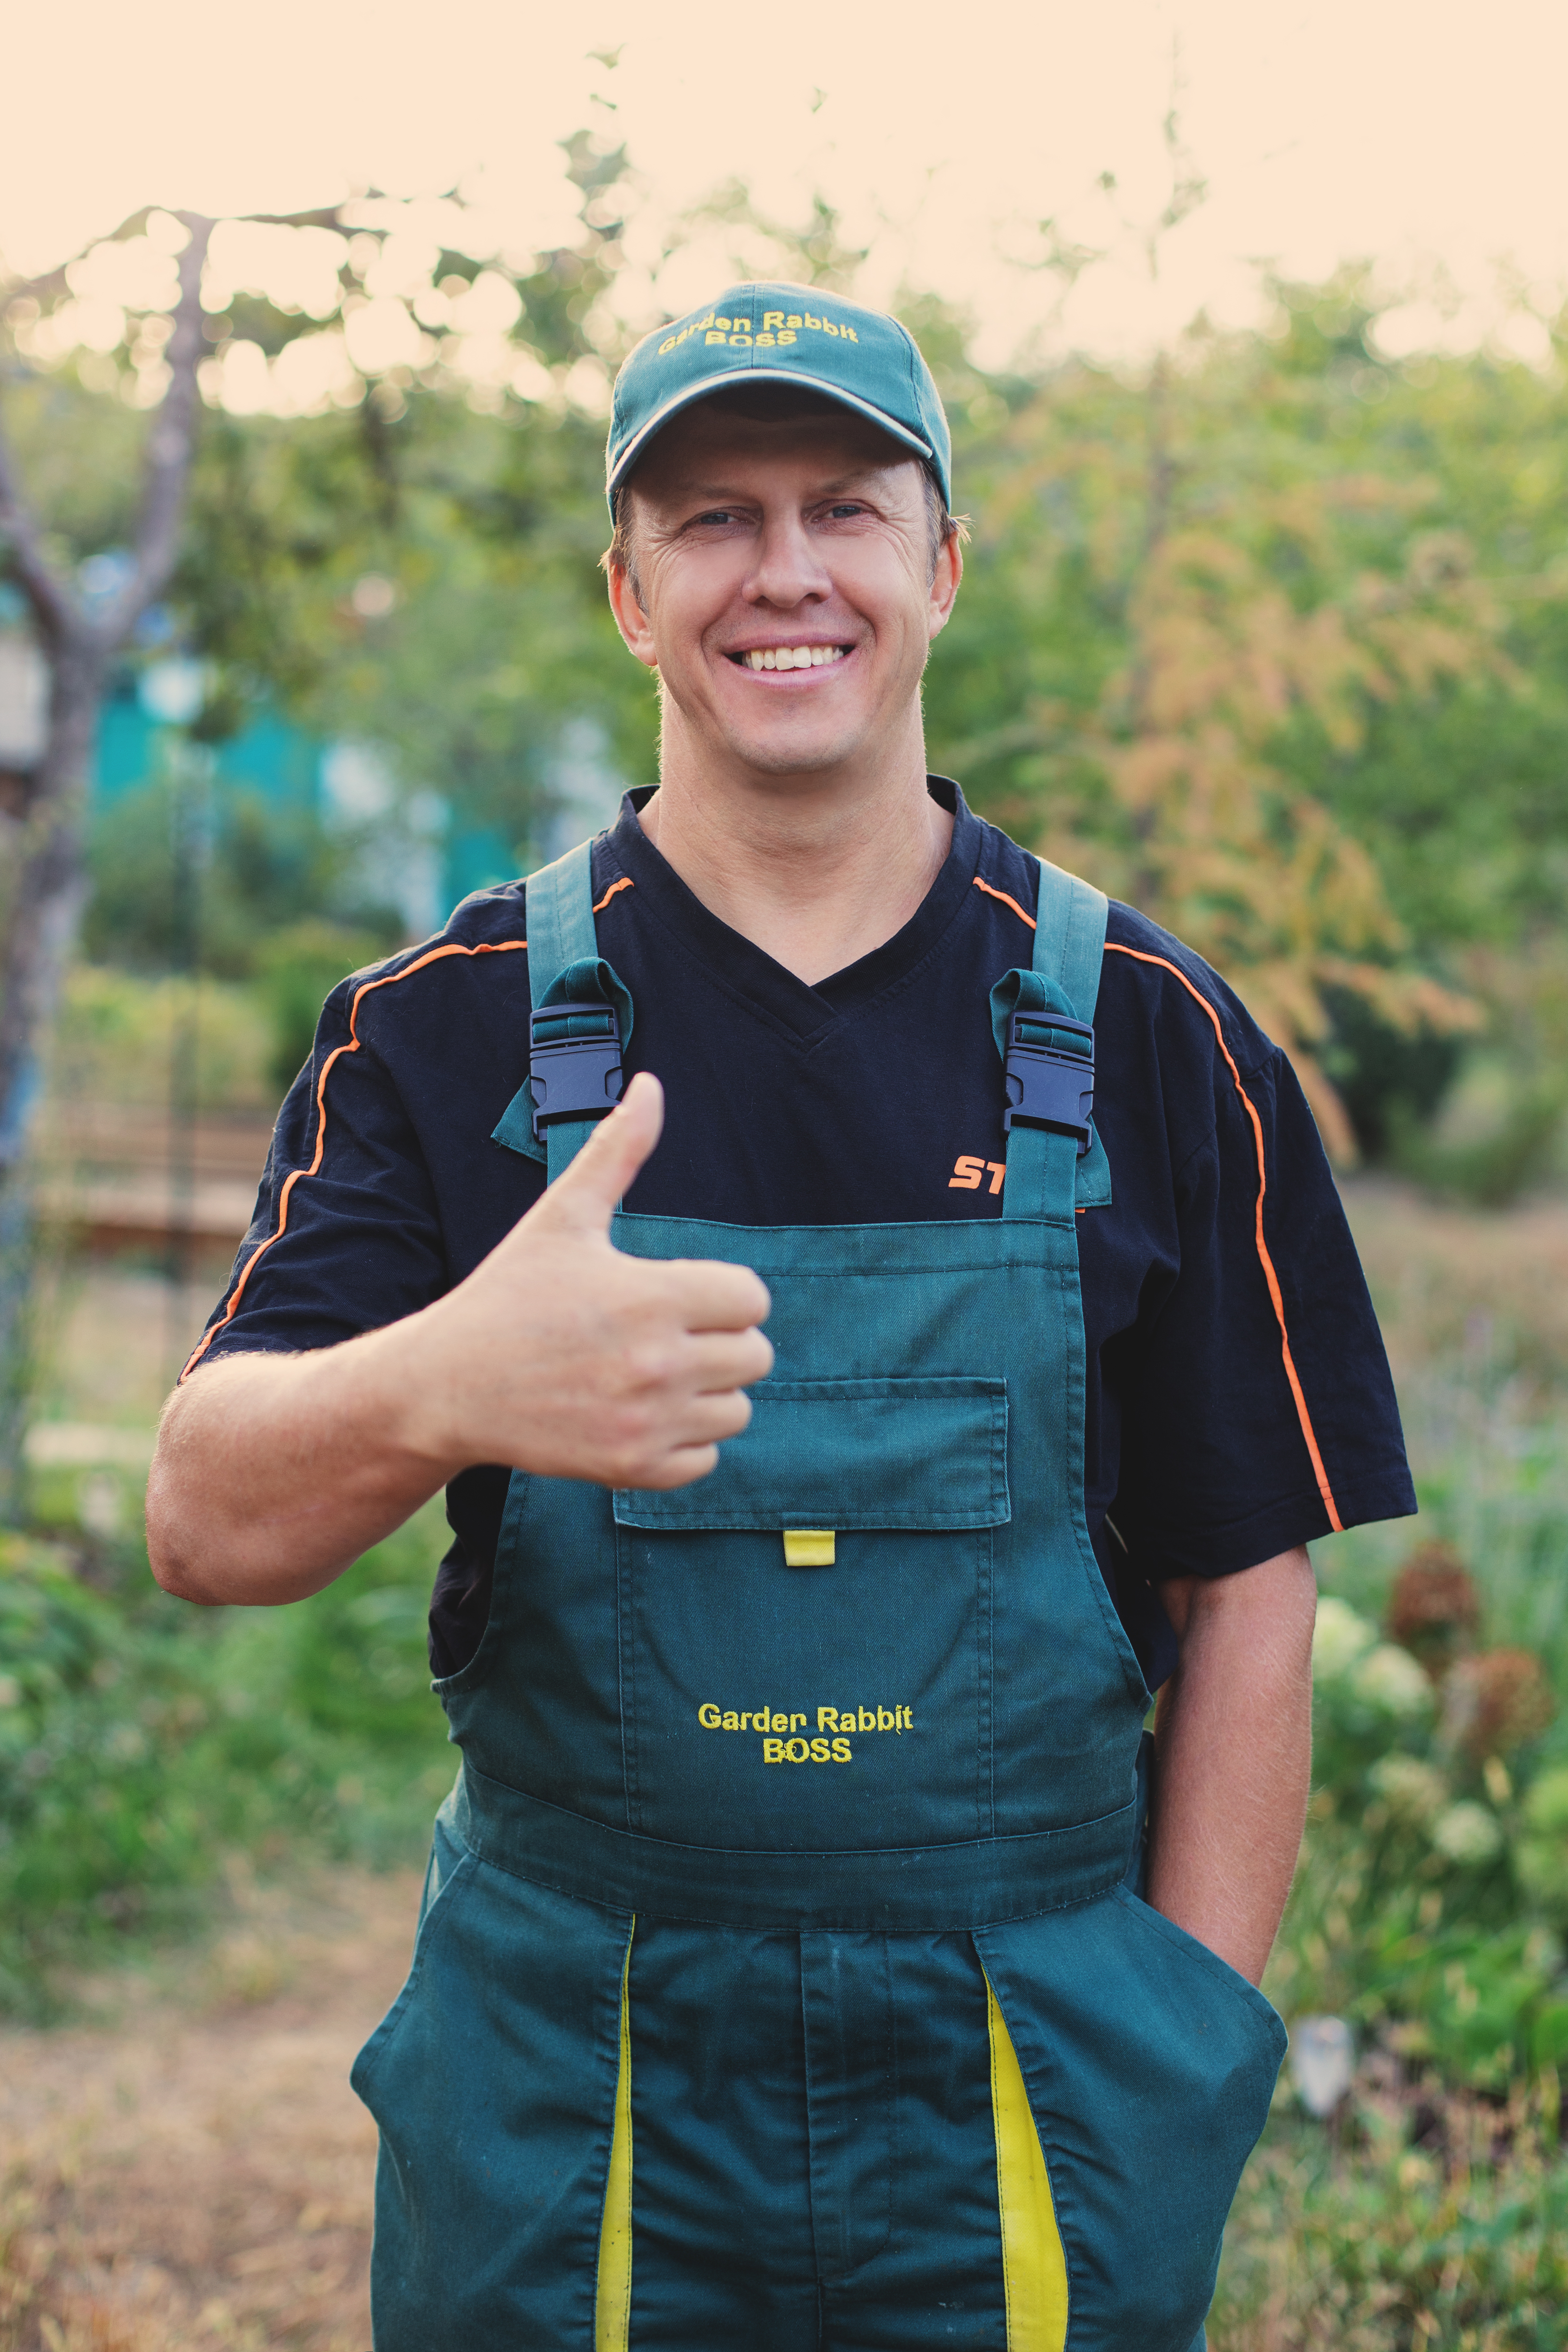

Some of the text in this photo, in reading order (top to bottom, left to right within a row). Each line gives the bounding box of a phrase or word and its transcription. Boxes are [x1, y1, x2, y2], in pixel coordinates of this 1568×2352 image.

[658, 311, 859, 355] Garden Rabbit
[705, 330, 797, 347] BOSS
[817, 1704, 913, 1735] Rabbit
[763, 1738, 852, 1764] BOSS
